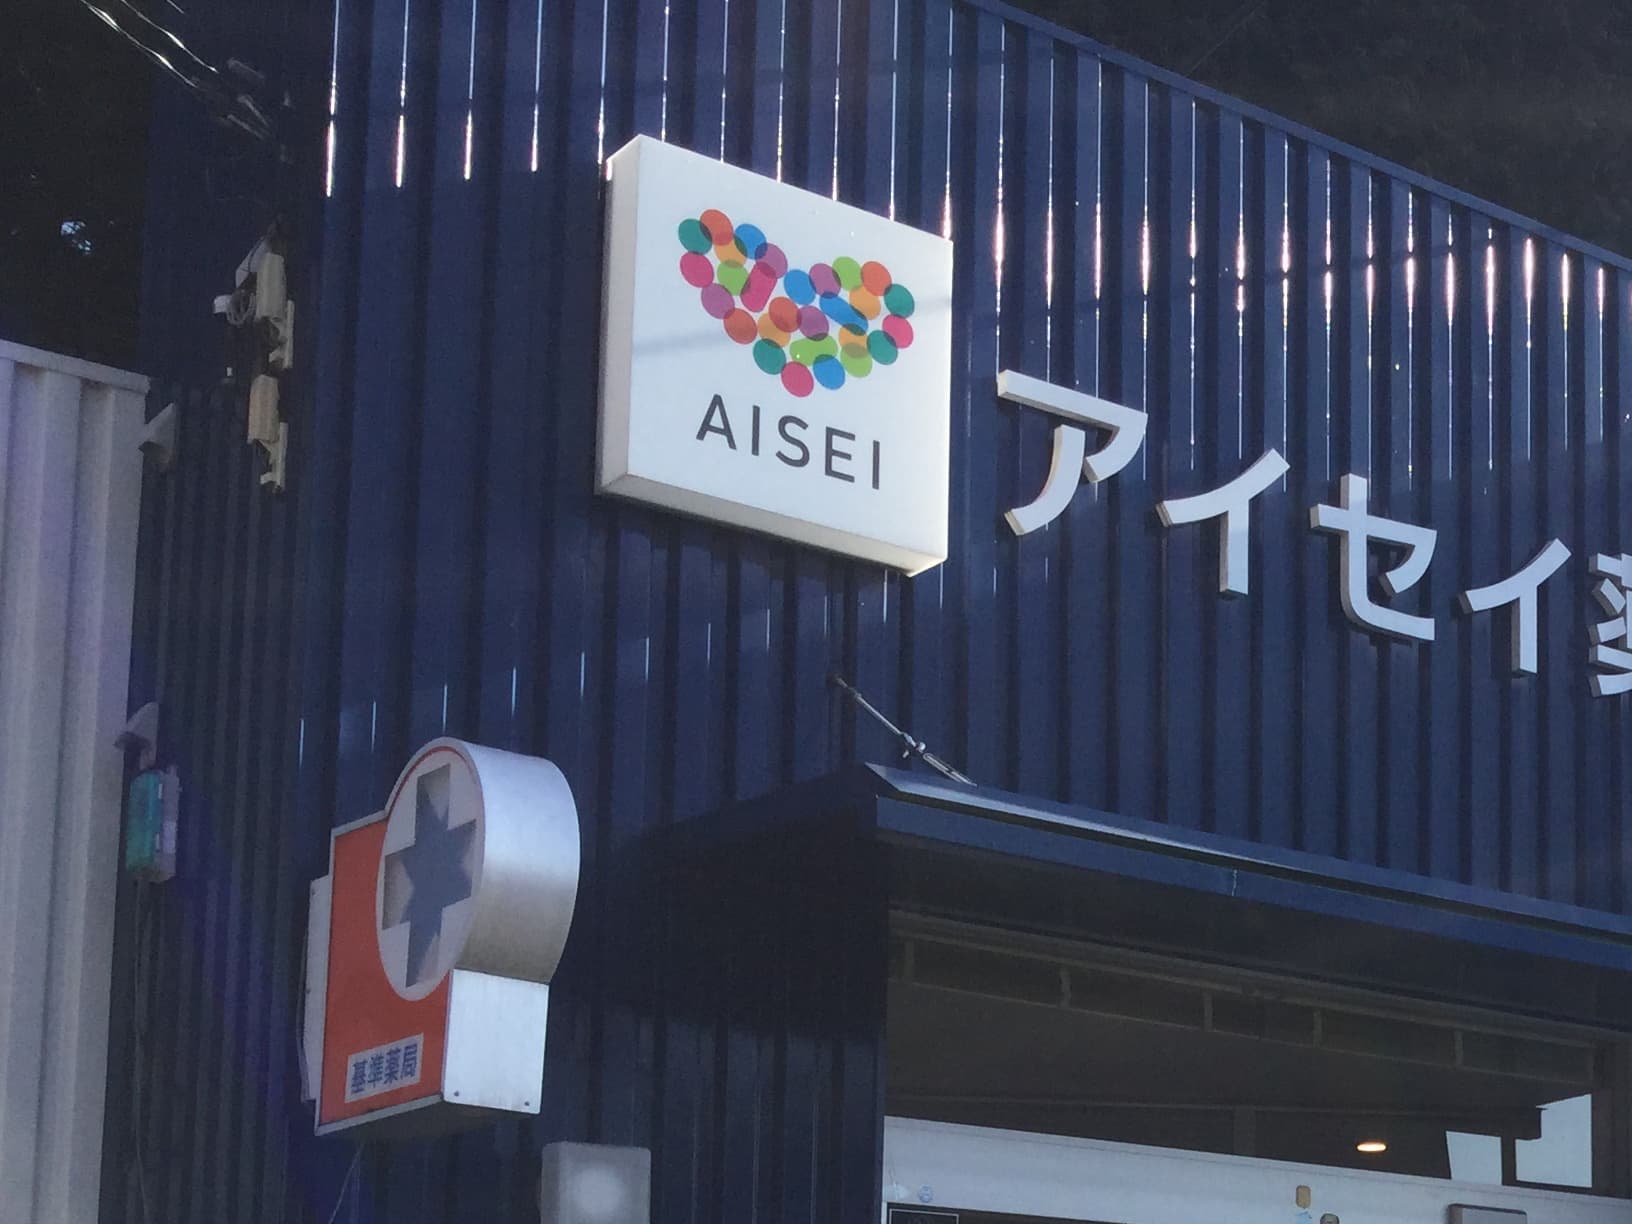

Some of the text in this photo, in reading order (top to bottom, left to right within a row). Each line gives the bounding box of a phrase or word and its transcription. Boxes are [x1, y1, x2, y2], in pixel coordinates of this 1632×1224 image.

[696, 394, 879, 490] AISEI
[350, 1043, 419, 1094] 基準薬局
